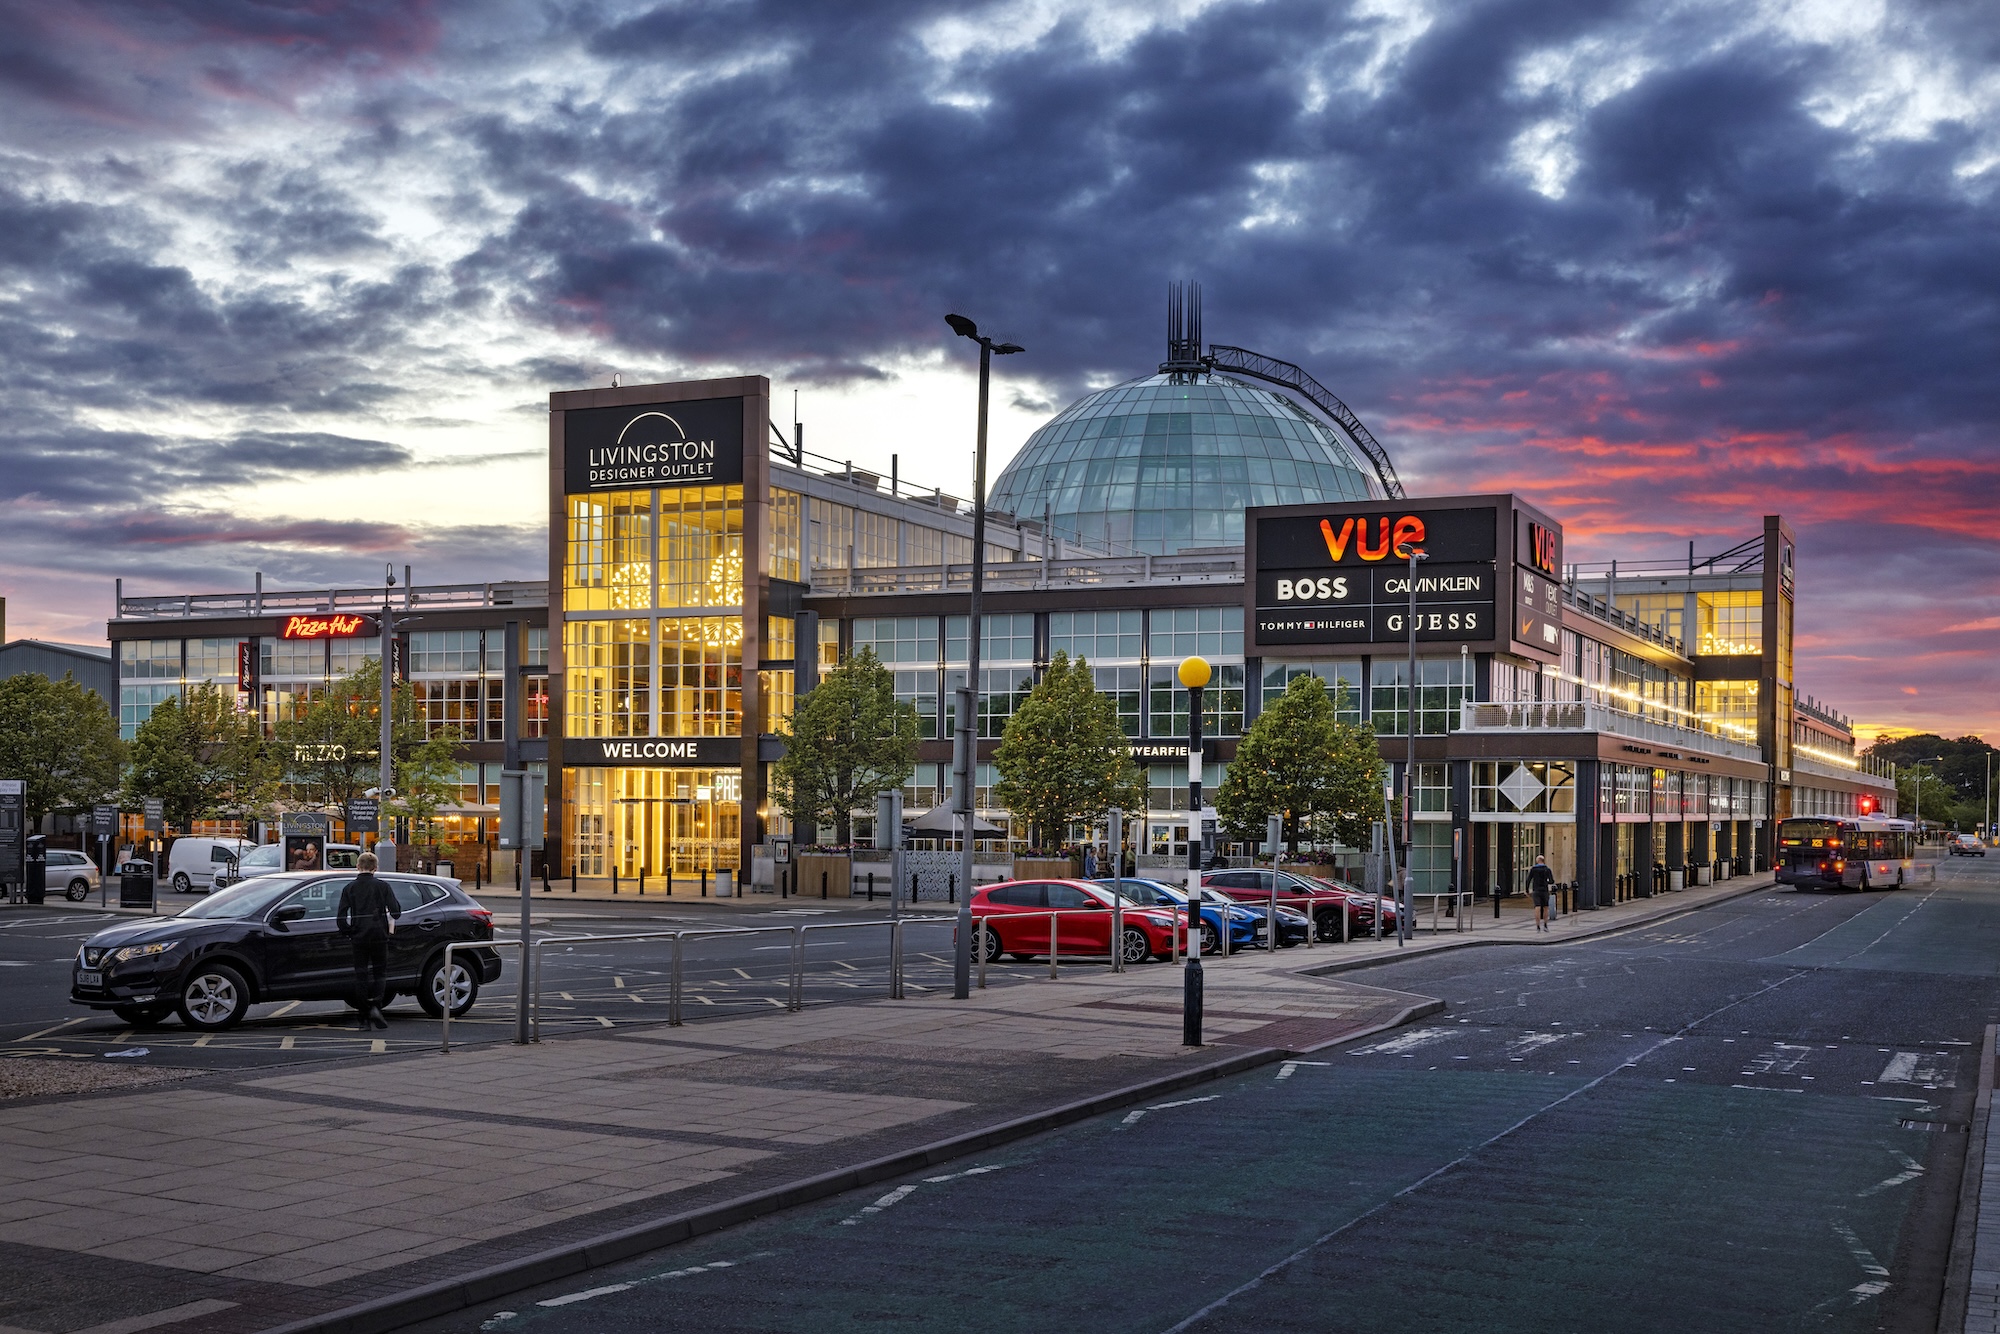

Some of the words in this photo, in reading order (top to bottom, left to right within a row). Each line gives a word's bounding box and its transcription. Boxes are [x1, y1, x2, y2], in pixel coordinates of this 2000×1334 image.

[589, 440, 714, 467] LIVINGSTON
[589, 467, 655, 481] DESIGNER
[660, 462, 714, 476] OUTLET
[1277, 577, 1348, 600] BOSS
[1384, 577, 1437, 593] CALVIN
[1440, 576, 1480, 592] KLEIN
[285, 615, 328, 637] Pizza
[329, 615, 363, 635] Hut
[1259, 621, 1302, 631] TOMMY
[1317, 620, 1366, 629] HILFIGER
[602, 742, 698, 758] WELCOME
[716, 775, 742, 800] PRE
